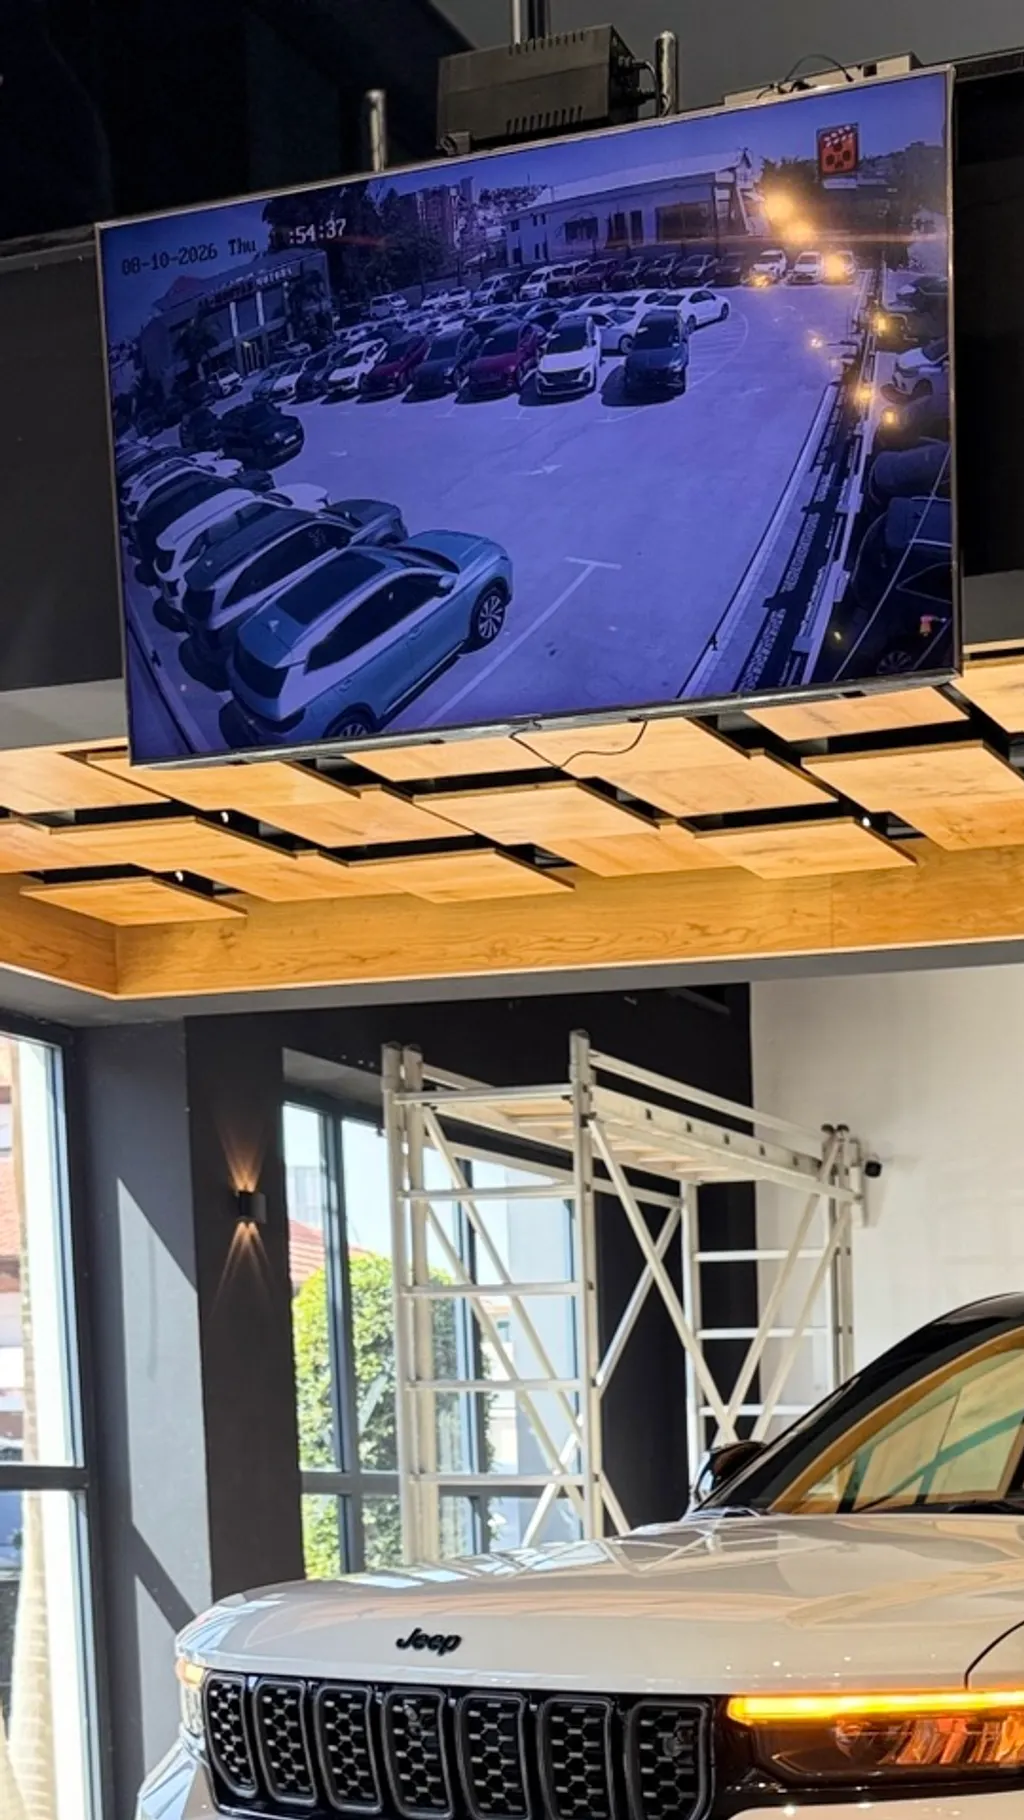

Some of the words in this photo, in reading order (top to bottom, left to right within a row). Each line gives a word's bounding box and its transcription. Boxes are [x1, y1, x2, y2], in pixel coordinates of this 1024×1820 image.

[228, 237, 257, 256] Thu
[274, 218, 347, 247] :54:37
[395, 1627, 462, 1656] Jeep
